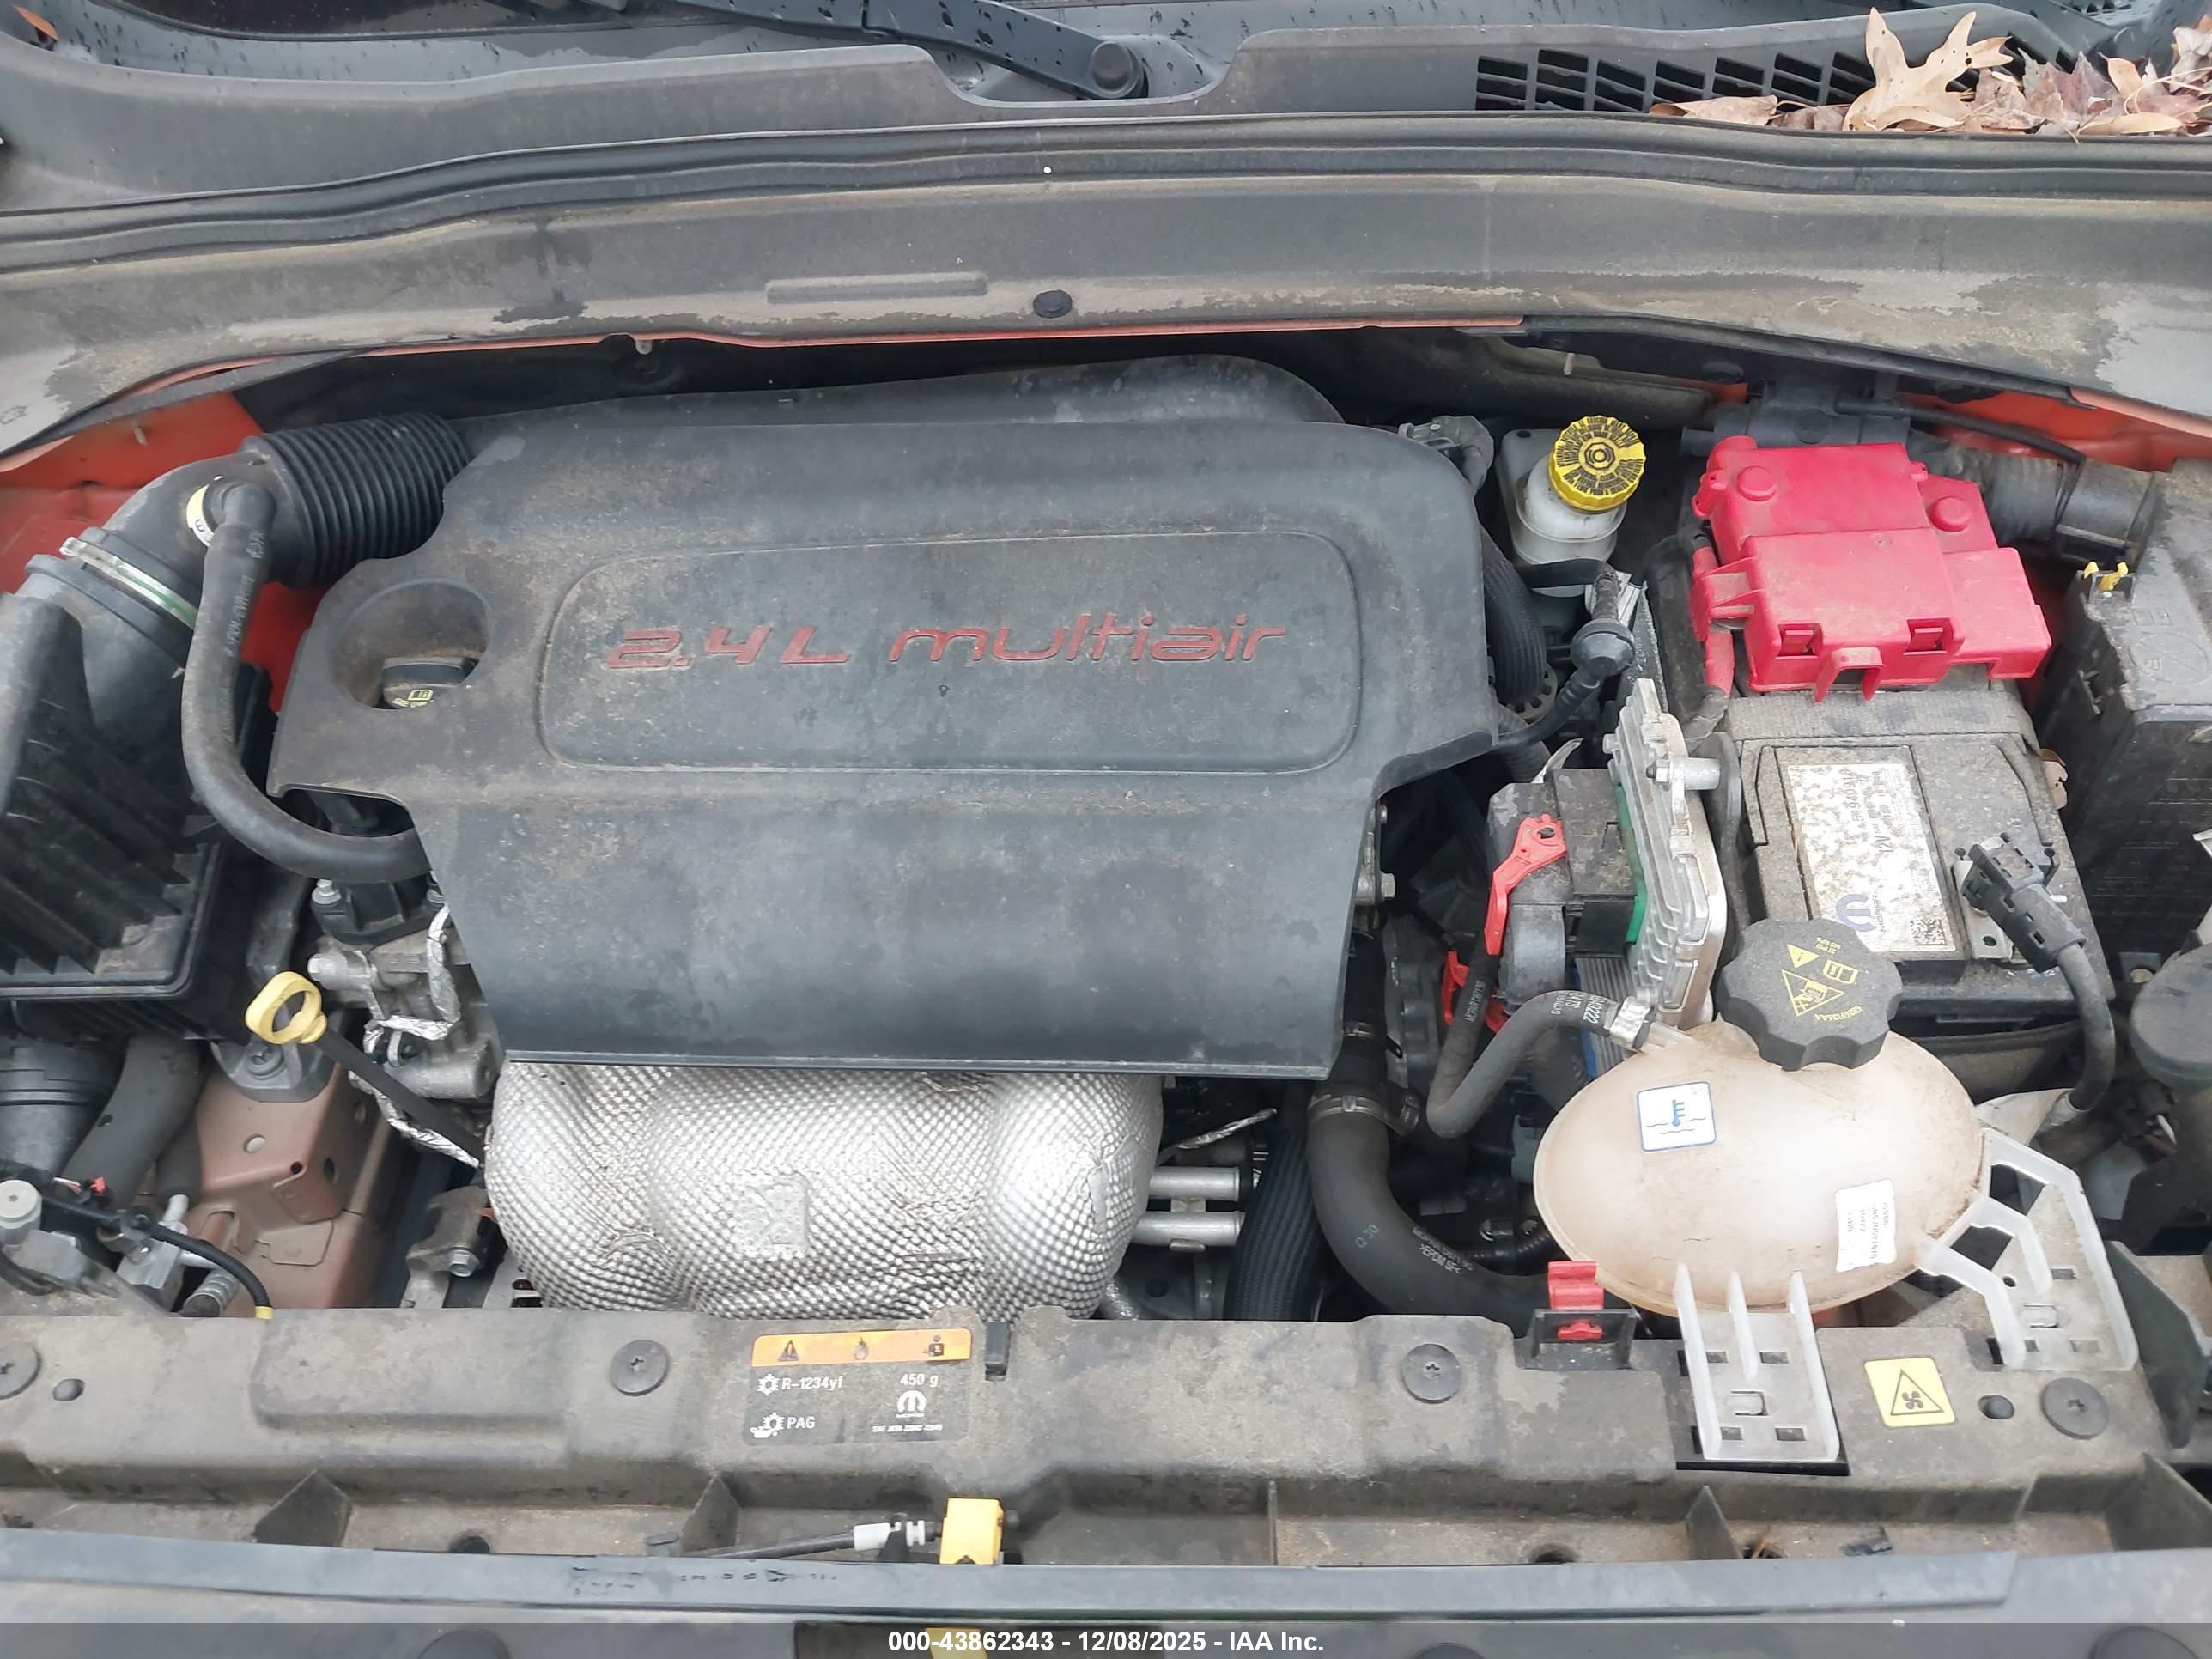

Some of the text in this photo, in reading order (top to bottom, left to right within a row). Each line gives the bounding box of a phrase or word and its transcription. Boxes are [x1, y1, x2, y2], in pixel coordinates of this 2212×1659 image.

[889, 611, 1286, 664] multiair
[781, 1373, 939, 1390] R-1234yf 450 g
[787, 1416, 816, 1429] PAG
